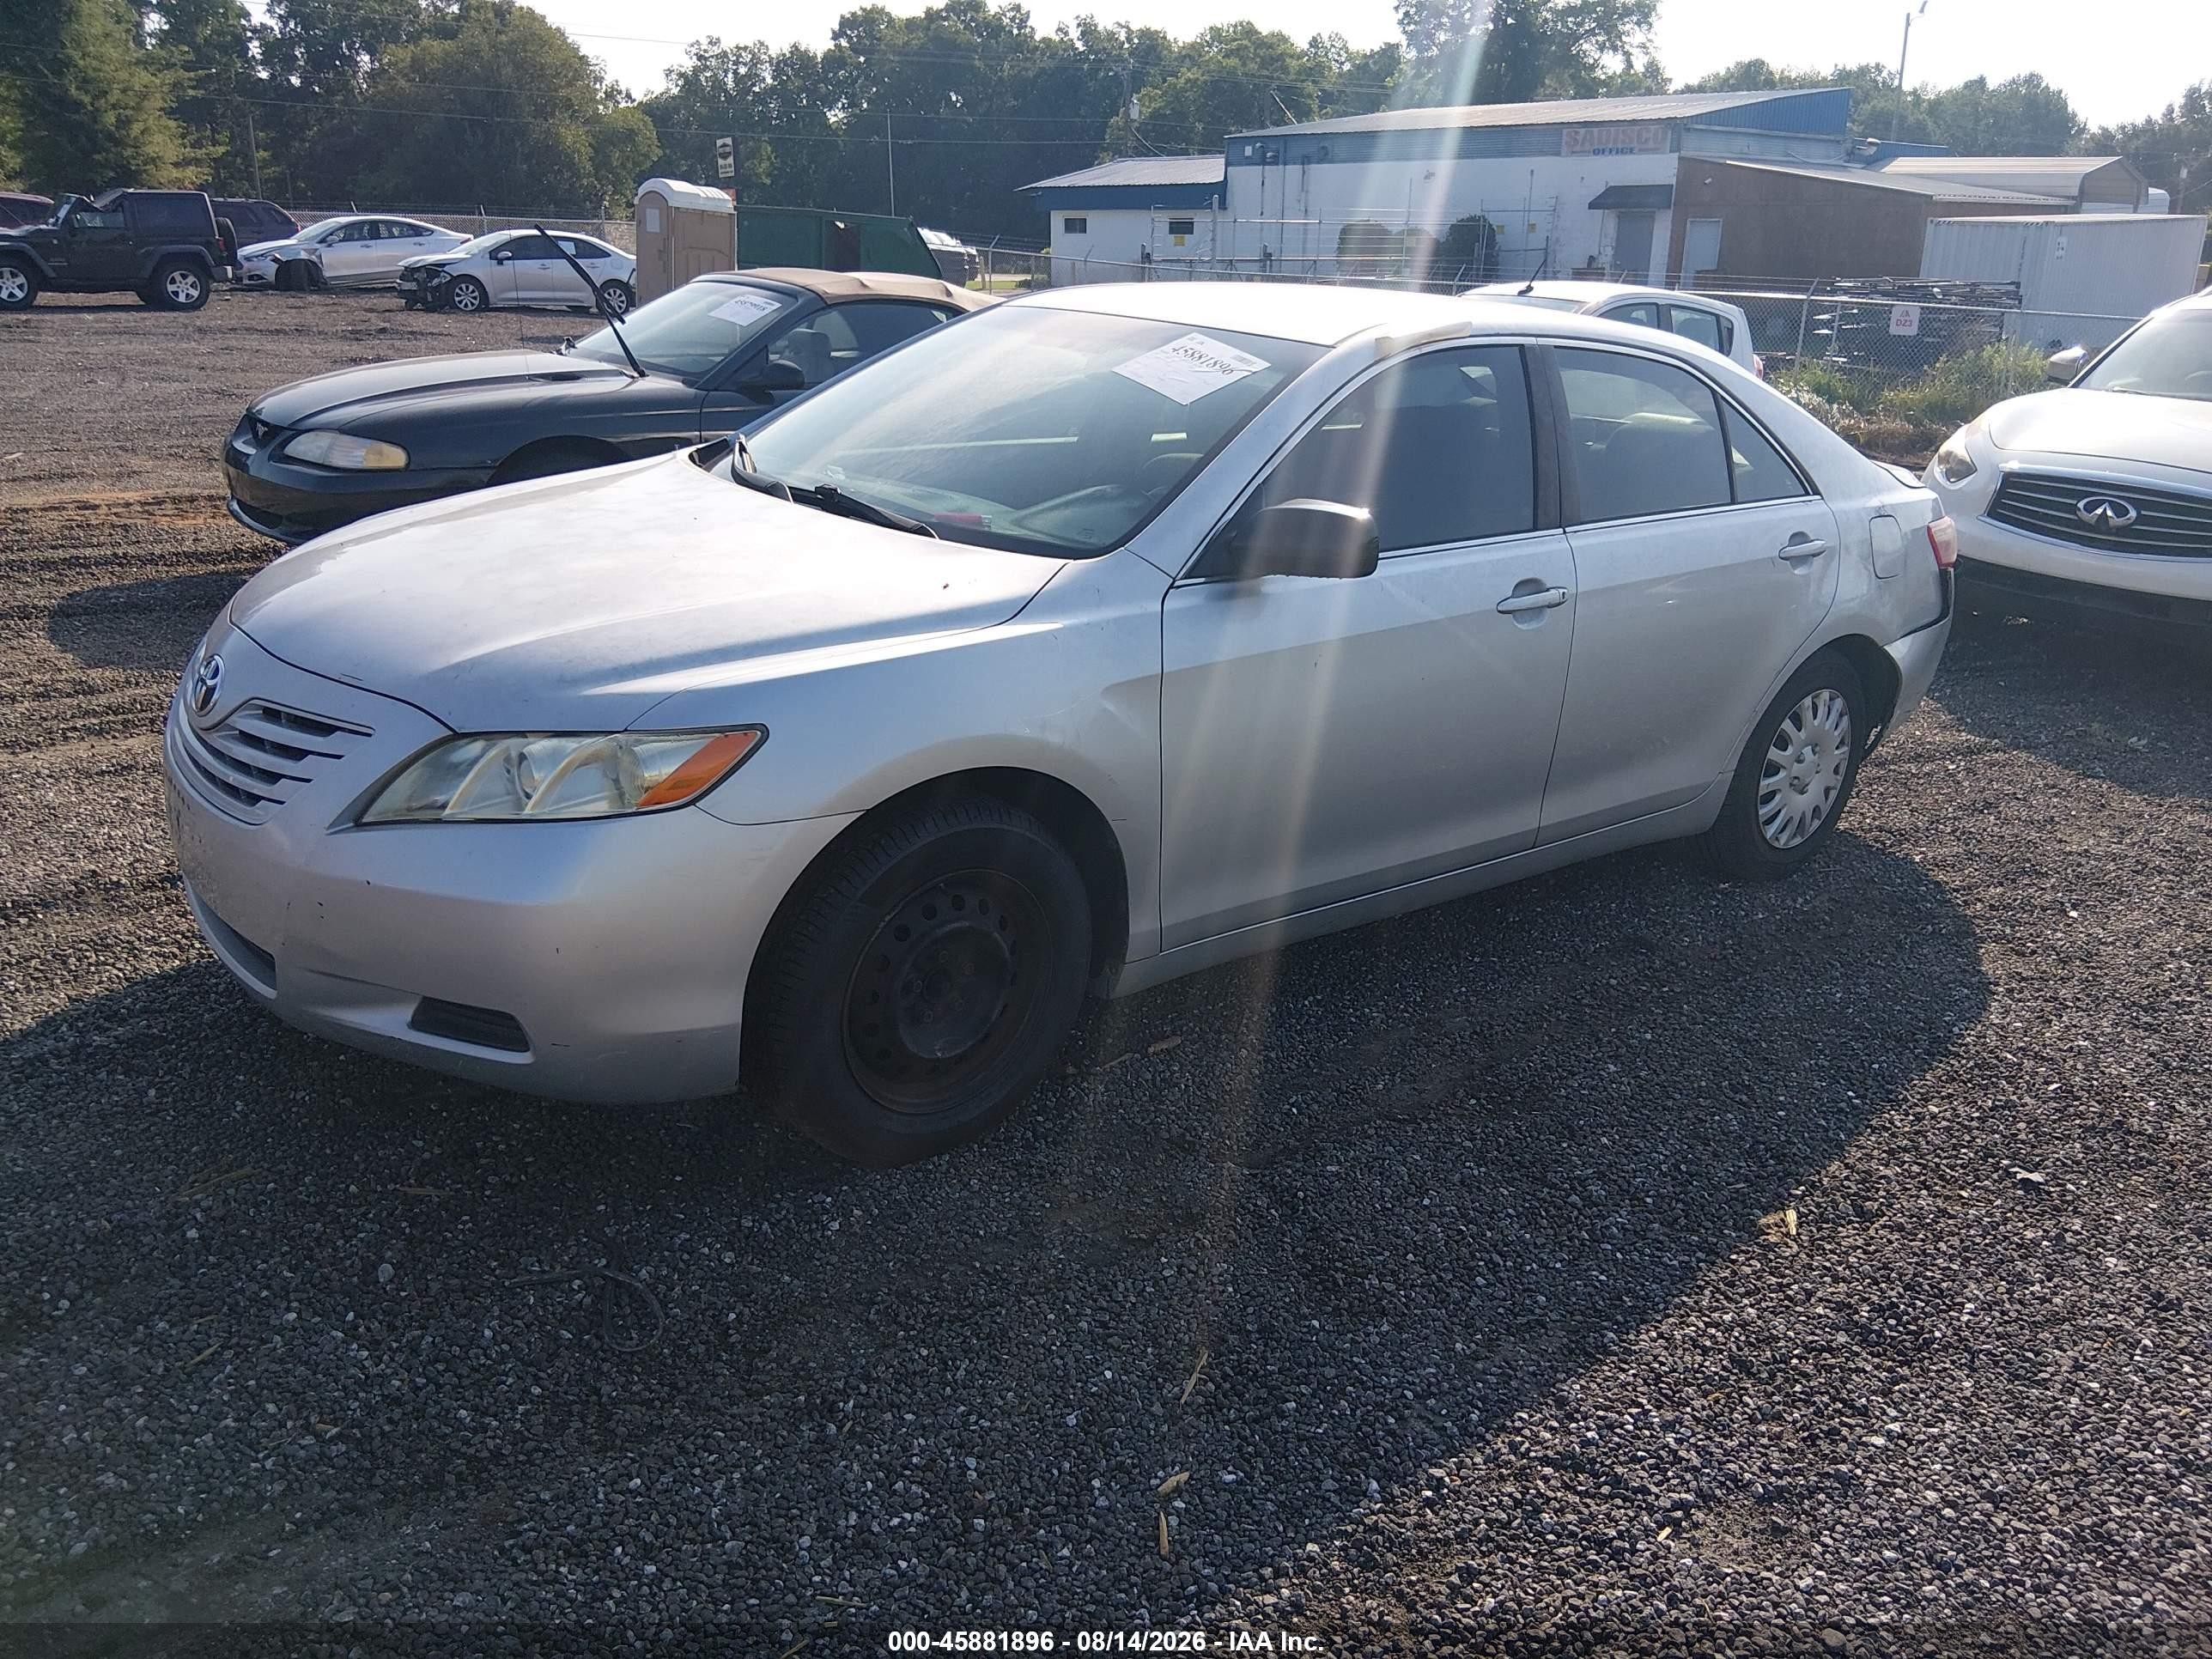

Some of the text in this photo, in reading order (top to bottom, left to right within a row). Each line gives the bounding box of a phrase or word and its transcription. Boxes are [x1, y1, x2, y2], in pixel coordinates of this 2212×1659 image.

[1565, 126, 1668, 146] SADISCO
[1592, 147, 1636, 155] OFFICE
[1896, 319, 1913, 327] DZ3
[1171, 345, 1234, 375] 45881896
